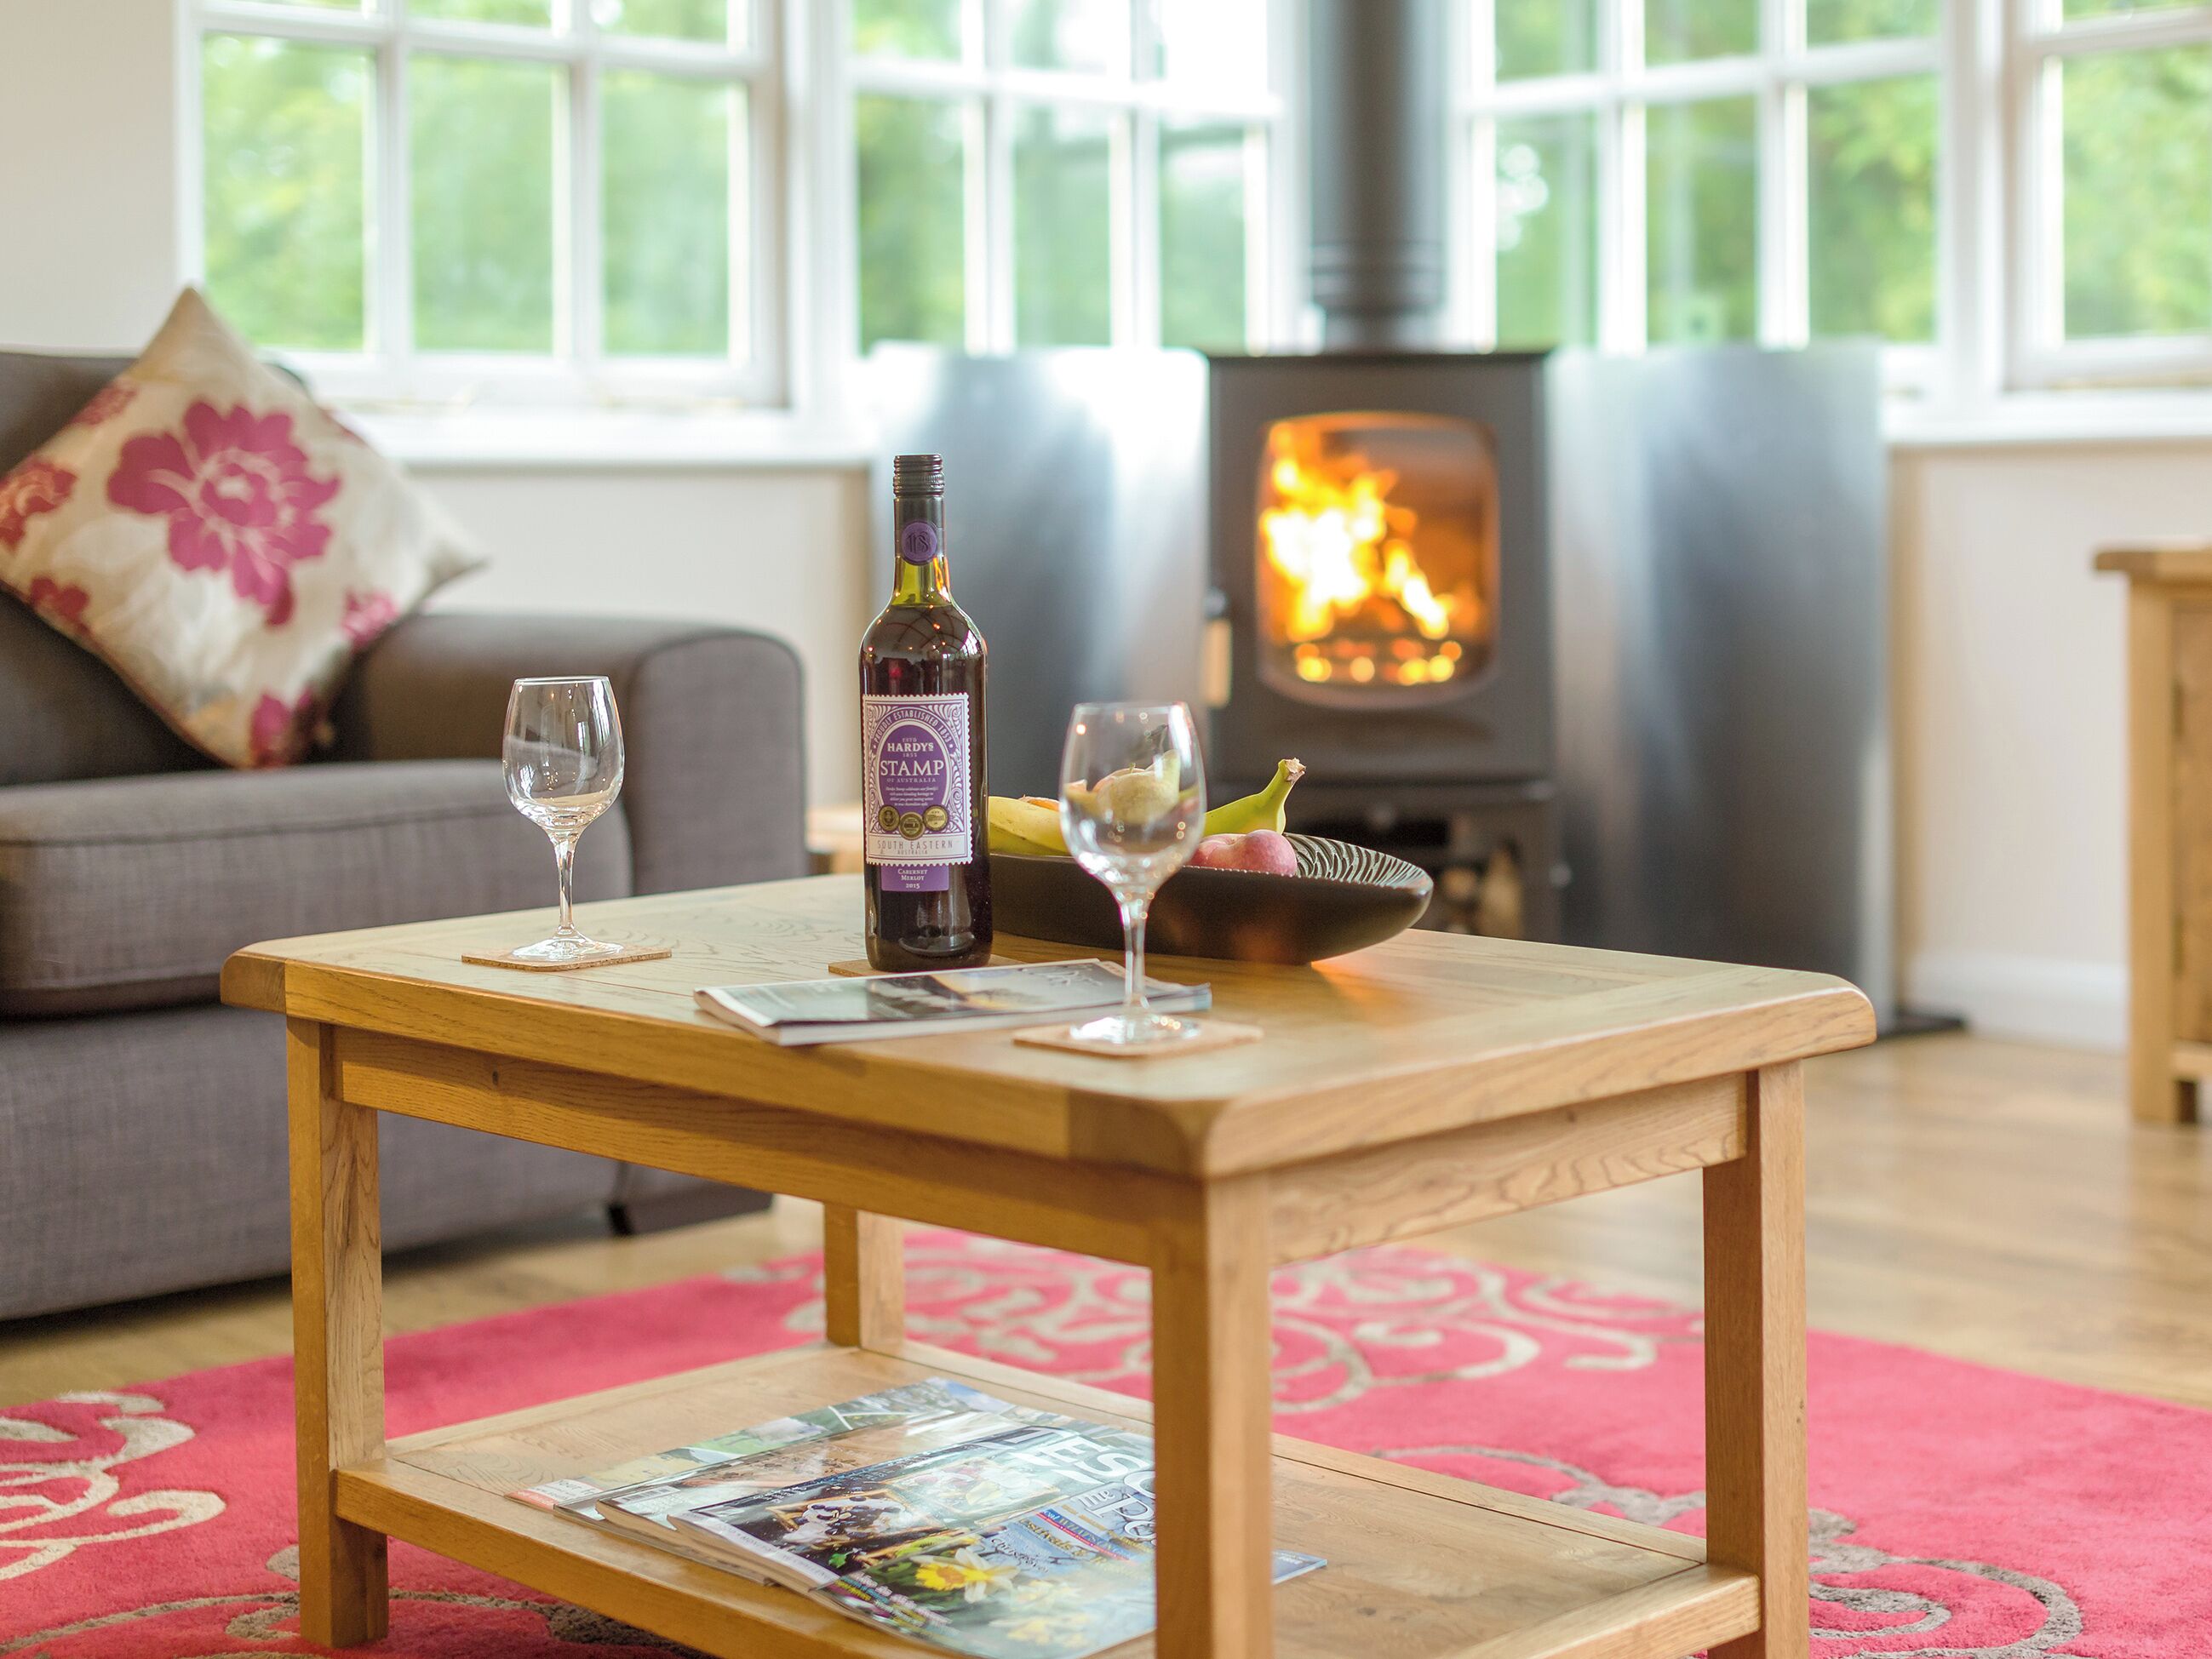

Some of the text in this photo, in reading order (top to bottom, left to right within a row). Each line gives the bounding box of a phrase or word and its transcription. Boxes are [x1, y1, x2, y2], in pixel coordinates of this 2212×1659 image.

[874, 710, 952, 743] PROUDLY ESTABLISHED 1853
[880, 759, 945, 776] STAMP
[877, 839, 954, 850] SOUTH EASTERN
[1004, 1426, 1155, 1500] TESC
[1085, 1492, 1155, 1546] Po
